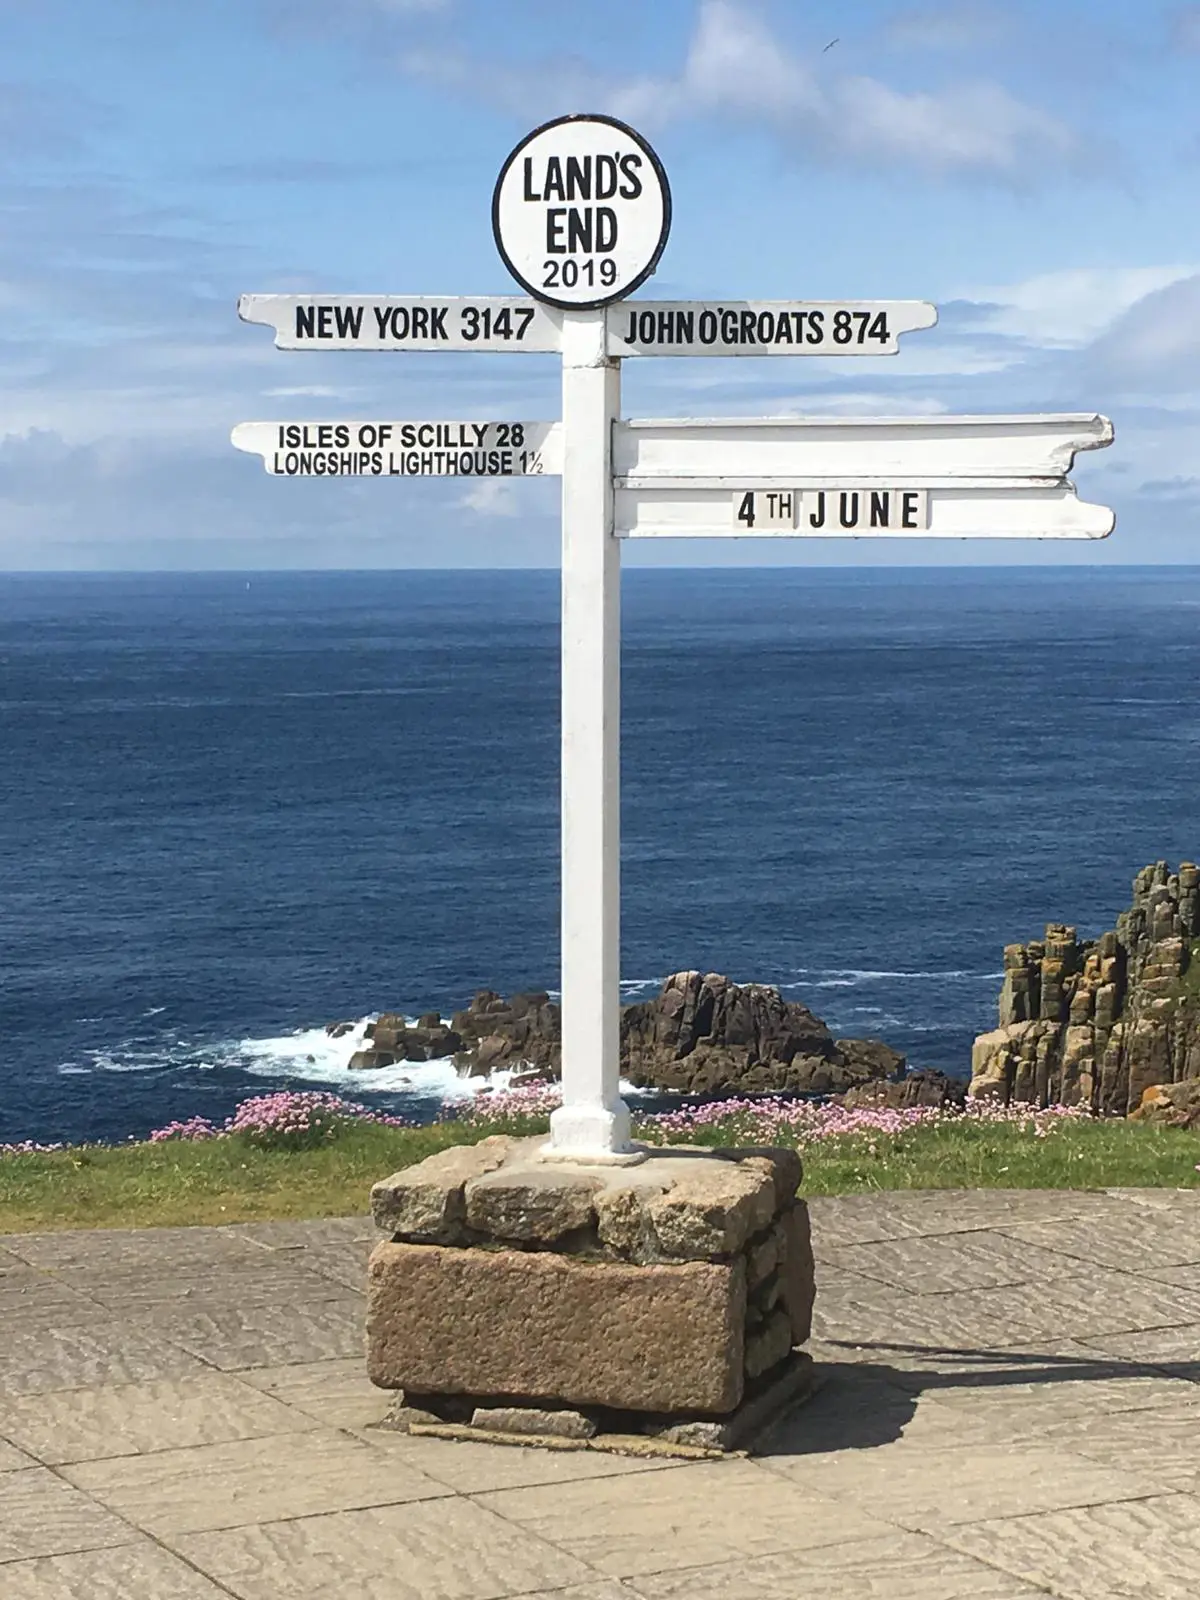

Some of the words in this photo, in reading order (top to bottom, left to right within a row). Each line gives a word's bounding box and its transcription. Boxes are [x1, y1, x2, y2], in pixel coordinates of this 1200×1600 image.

[523, 151, 643, 202] LAND'S
[546, 206, 618, 254] END
[542, 258, 617, 288] 2019
[295, 305, 365, 340] NEW
[373, 306, 449, 340] YORK
[460, 307, 535, 341] 3147
[623, 310, 695, 345] JOHN
[698, 306, 825, 345] O'GROATS
[832, 310, 891, 345] 874
[279, 425, 350, 449] ISLES
[358, 424, 393, 449] OF
[400, 424, 490, 448] SCILLY
[495, 423, 525, 448] 28
[274, 451, 383, 476] LONGSHIPS
[389, 451, 513, 476] LIGHTHOUSE
[809, 491, 919, 529] JUNE
